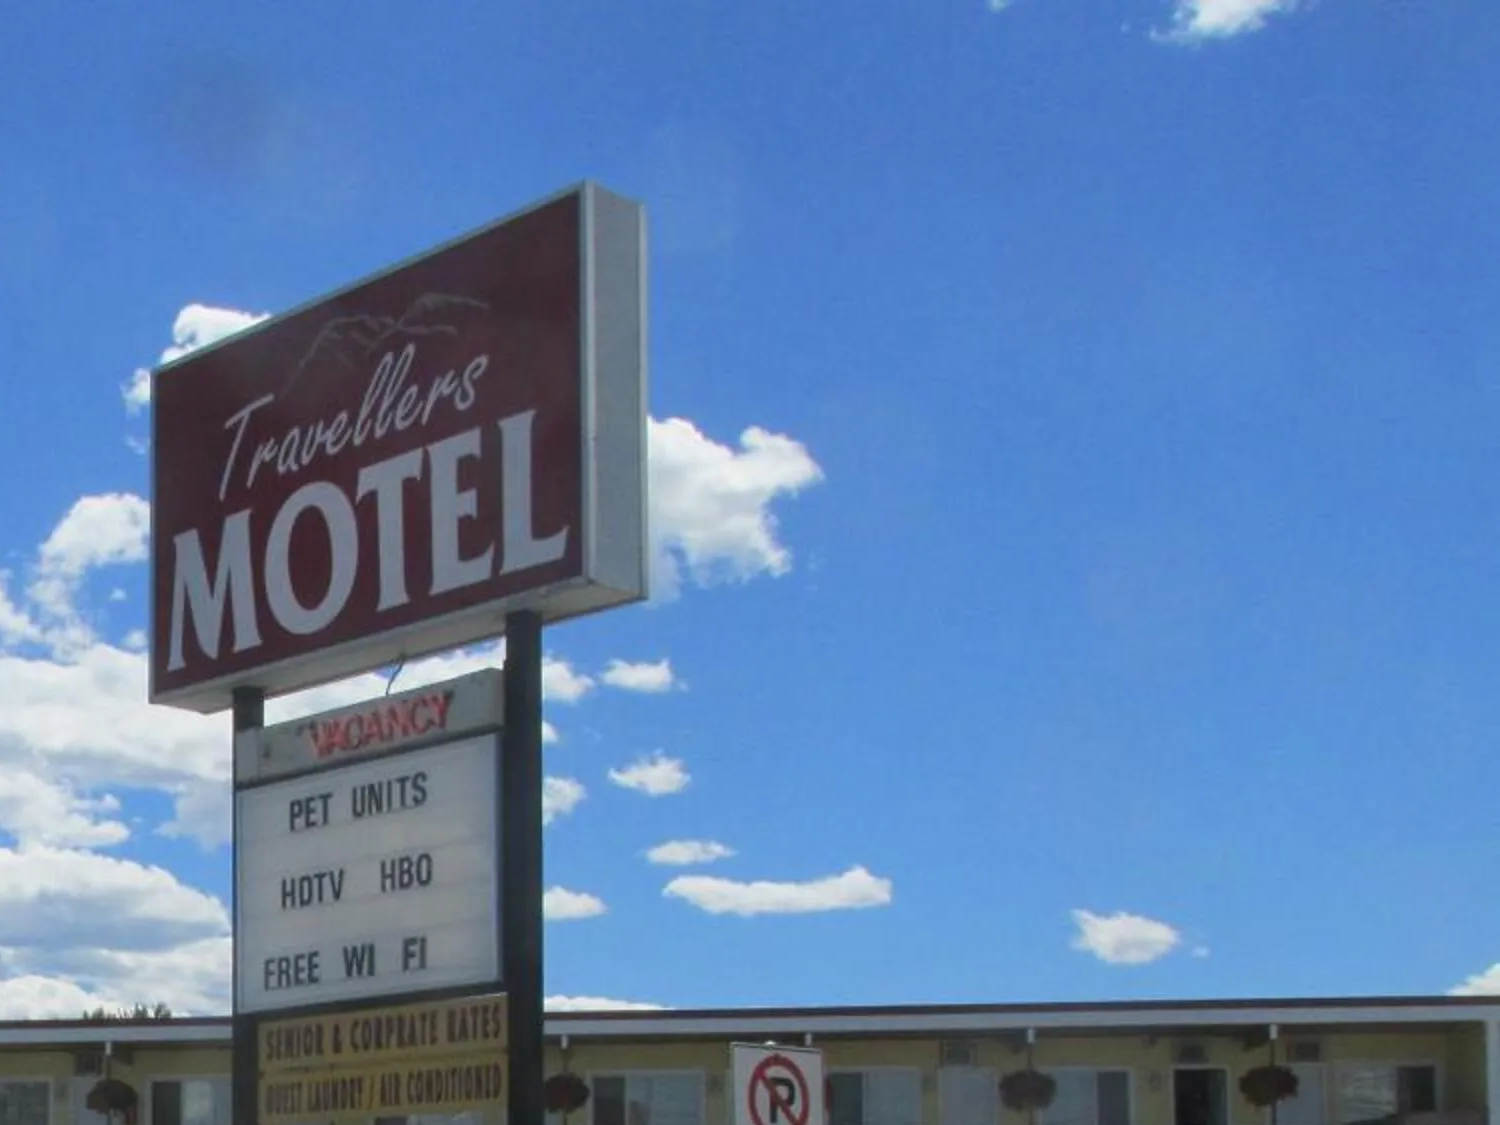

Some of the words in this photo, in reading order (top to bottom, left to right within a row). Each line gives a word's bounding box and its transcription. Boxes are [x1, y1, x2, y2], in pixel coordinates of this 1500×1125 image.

[218, 343, 490, 501] Travellers
[167, 409, 570, 672] MOTEL
[309, 690, 454, 757] VACANCY
[289, 793, 332, 832] PET
[352, 772, 428, 818] UNITS
[281, 869, 345, 911] HDTV
[381, 853, 433, 893] HBO
[264, 951, 320, 992] FREE
[343, 944, 376, 978] WI
[403, 937, 427, 973] FI
[267, 1023, 325, 1060] SENIOR
[446, 1003, 500, 1042] RATES
[379, 1071, 400, 1106] AIR
[407, 1062, 500, 1105] CONDITIONED
